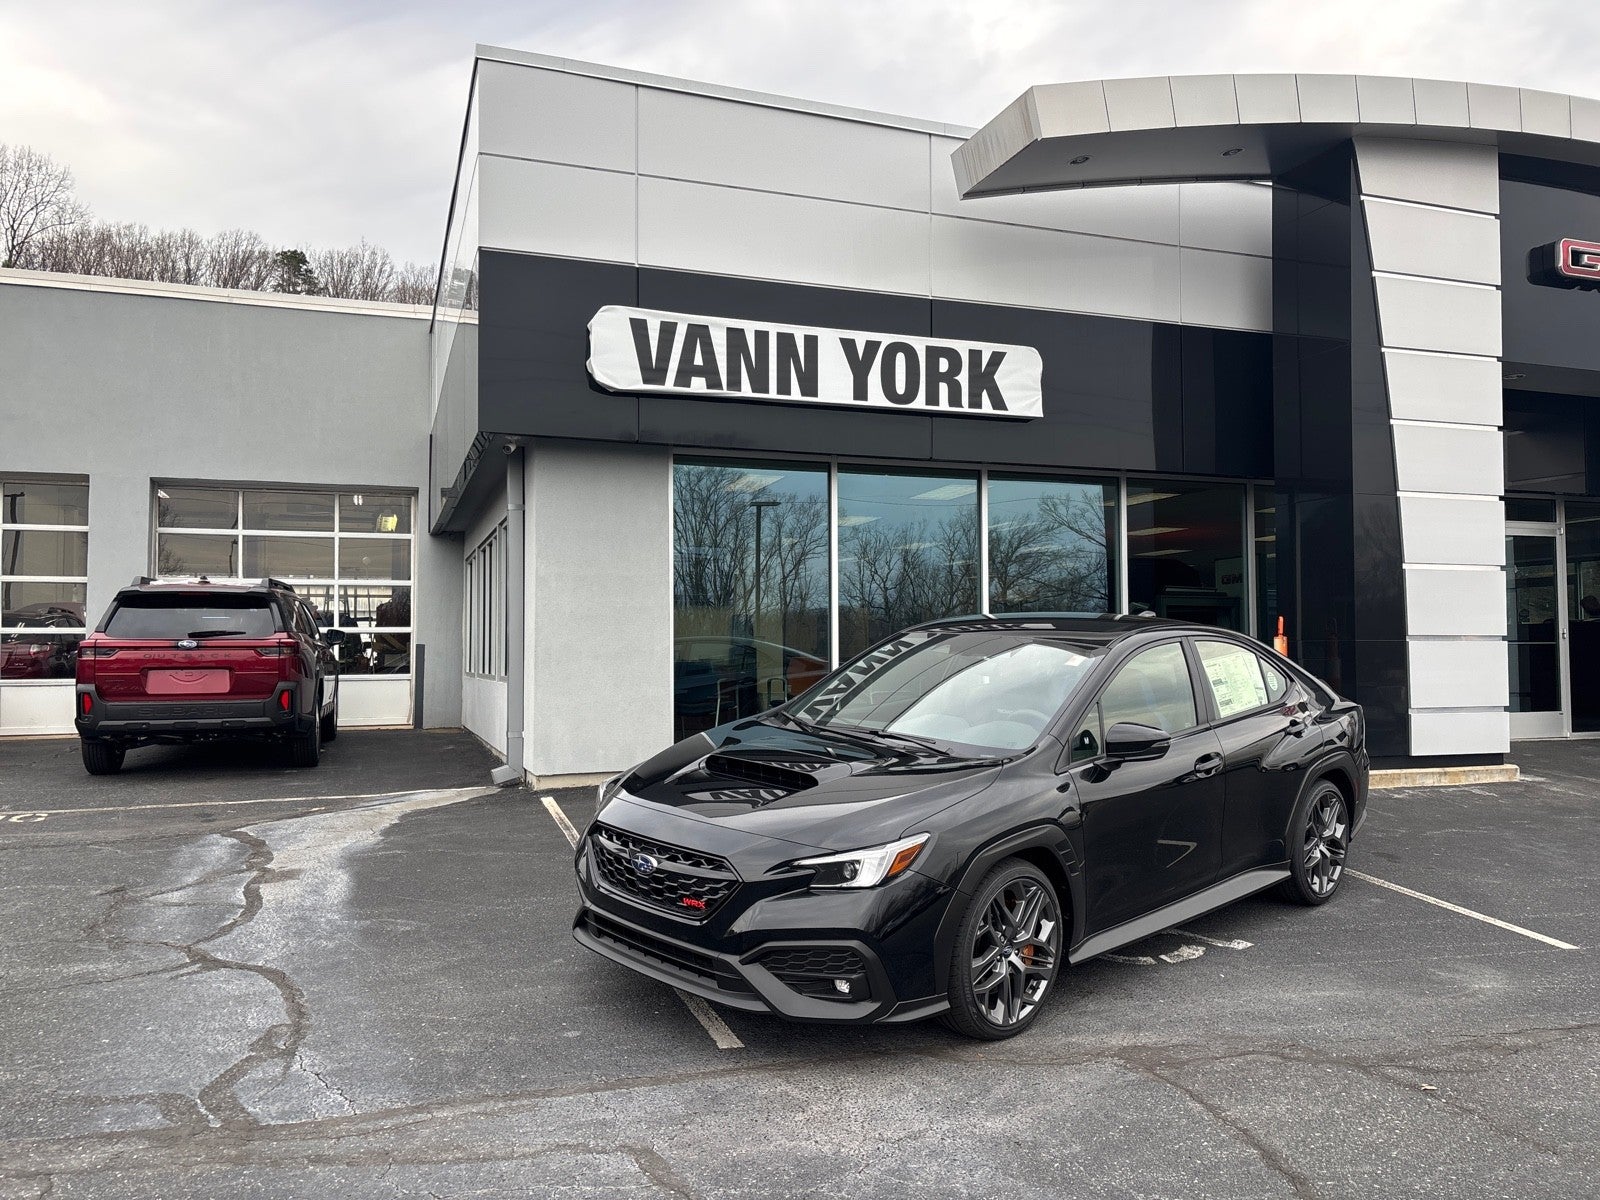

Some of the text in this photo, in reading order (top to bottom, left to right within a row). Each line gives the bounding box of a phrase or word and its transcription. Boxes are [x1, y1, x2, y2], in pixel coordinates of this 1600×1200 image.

[629, 317, 1009, 411] VANN YORK
[138, 708, 234, 717] SUBARU
[683, 897, 706, 910] WRX
